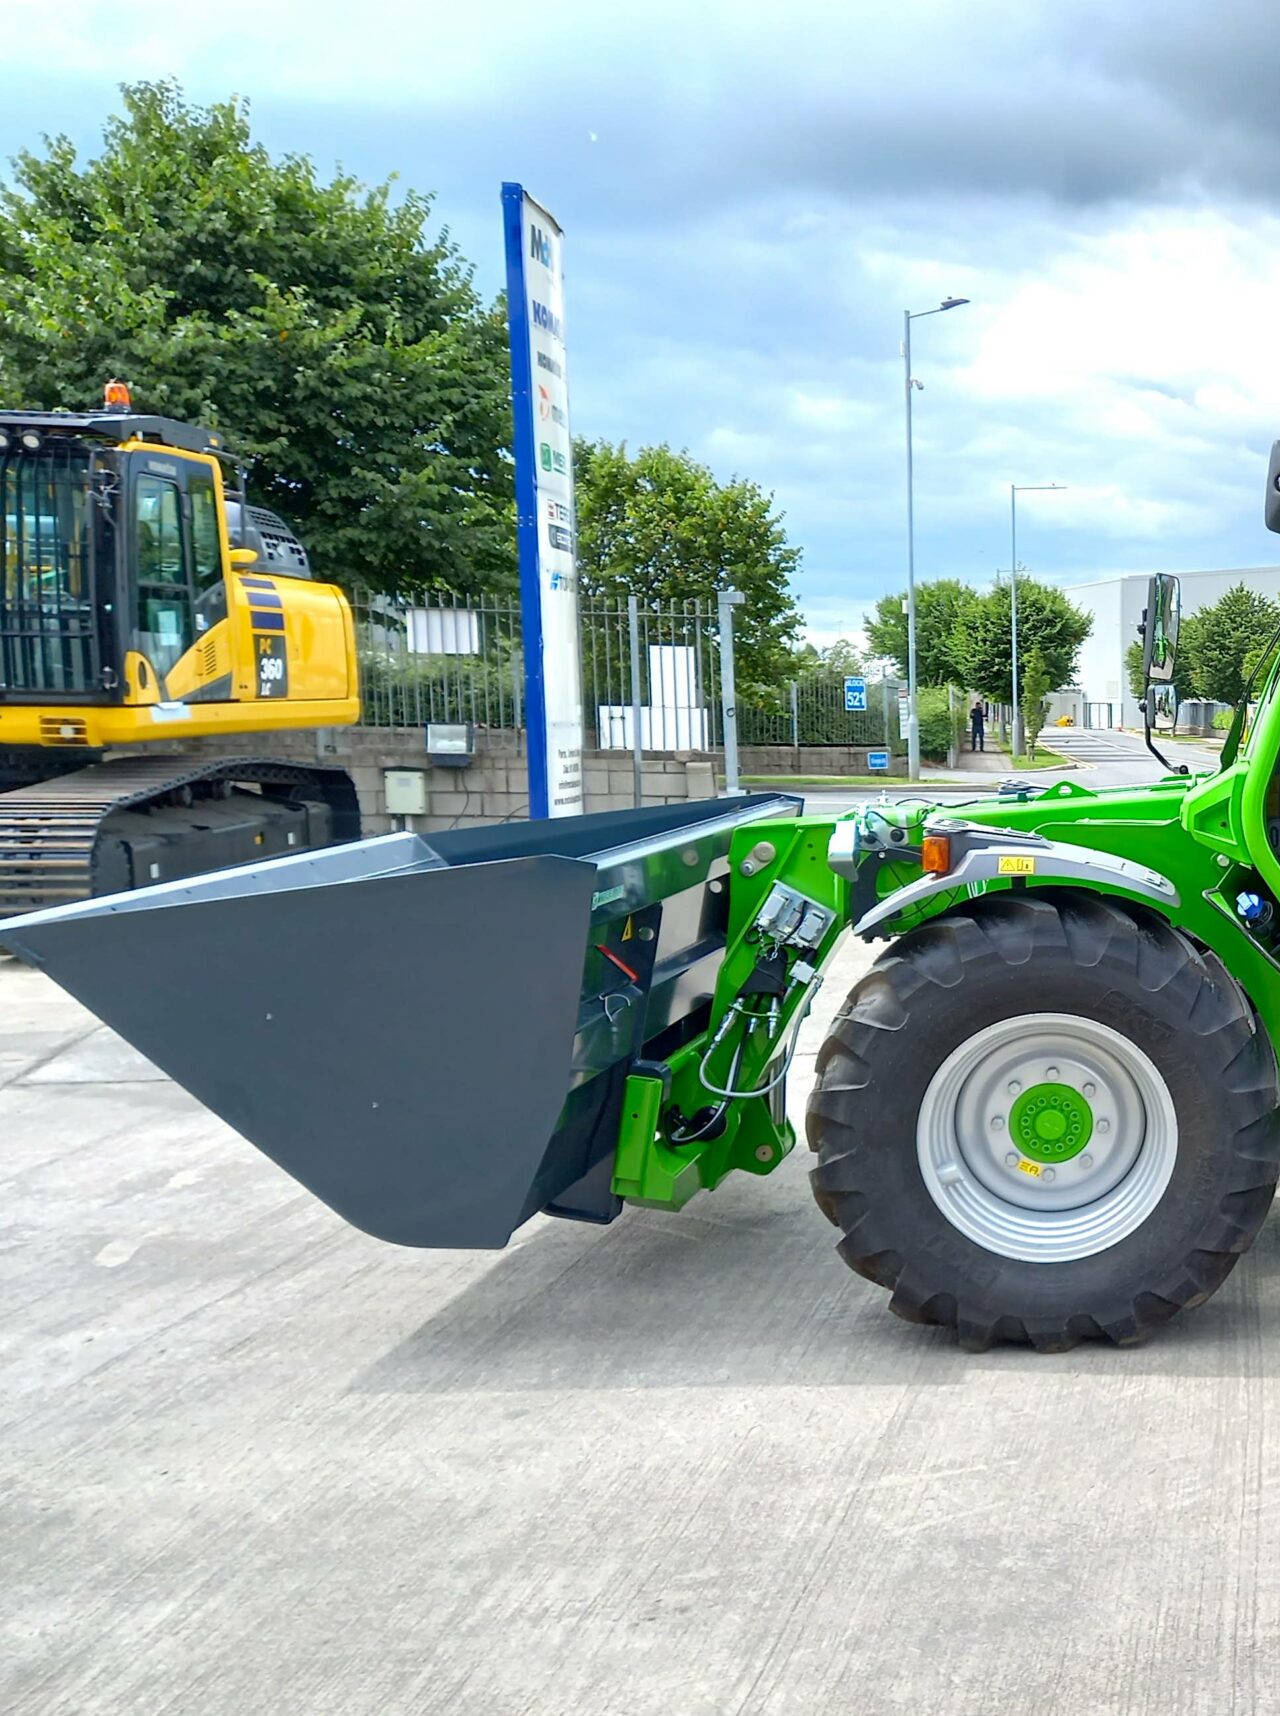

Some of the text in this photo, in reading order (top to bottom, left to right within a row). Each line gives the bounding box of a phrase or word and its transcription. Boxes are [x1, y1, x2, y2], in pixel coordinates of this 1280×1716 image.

[259, 638, 271, 655] PC
[260, 658, 283, 680] 360
[847, 692, 865, 706] 521
